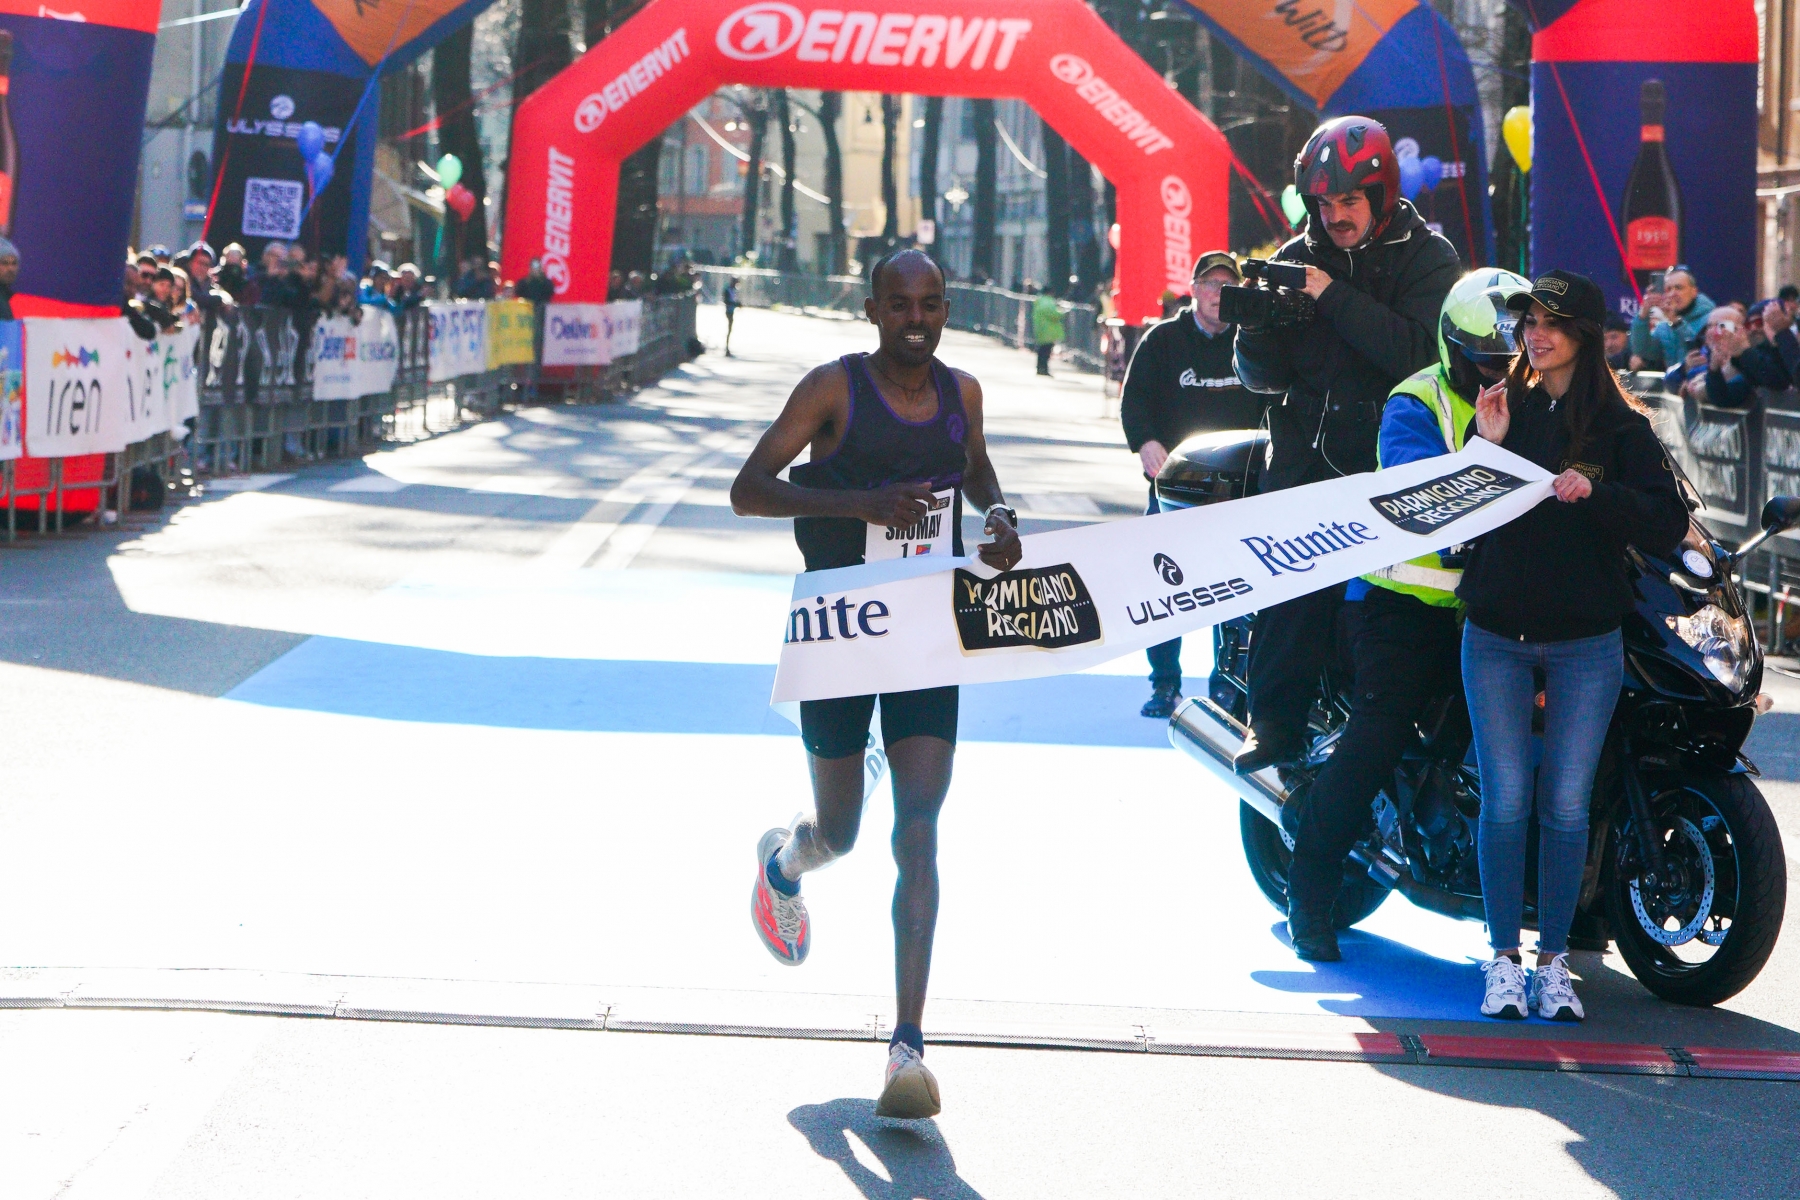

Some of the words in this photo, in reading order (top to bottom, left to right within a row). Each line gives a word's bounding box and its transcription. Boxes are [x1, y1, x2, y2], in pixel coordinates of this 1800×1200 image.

[796, 9, 1032, 71] ENERVIT
[605, 27, 691, 113] ENERVIT
[226, 117, 342, 143] ULYSSS
[1075, 76, 1174, 156] ENERVIT
[543, 146, 575, 257] ENERVIT
[1163, 213, 1192, 297] ENER
[1381, 467, 1498, 518] PARMIGIANO
[1564, 461, 1600, 474] PRMIGIANO
[1413, 482, 1512, 526] REGGIANO
[1240, 517, 1380, 577] Riunite
[784, 595, 892, 647] nite
[986, 604, 1079, 640] REGIANO
[1127, 576, 1254, 627] ULYSSES
